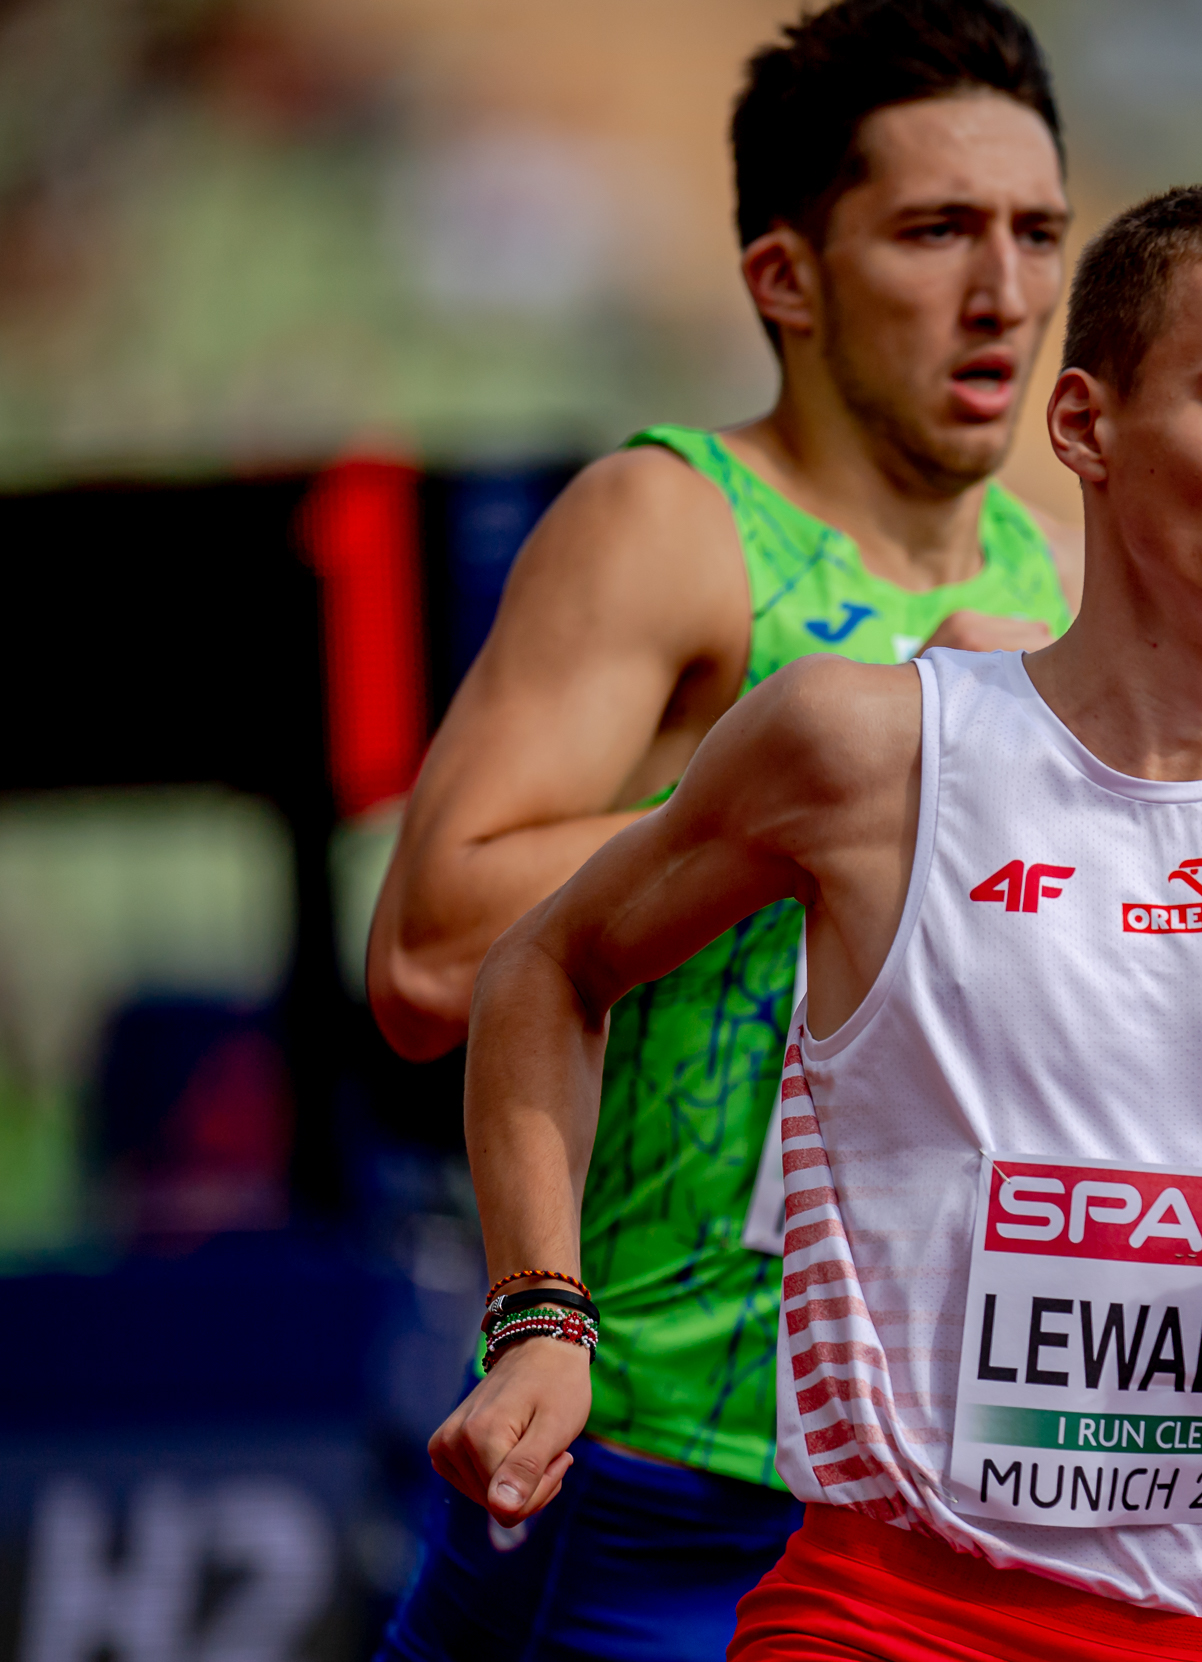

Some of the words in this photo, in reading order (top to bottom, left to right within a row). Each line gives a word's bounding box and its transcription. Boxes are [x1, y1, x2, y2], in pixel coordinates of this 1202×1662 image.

[969, 859, 1076, 913] 4F
[1057, 1417, 1066, 1445] I
[1078, 1418, 1145, 1448] RUN
[980, 1459, 1179, 1511] MUNICH
